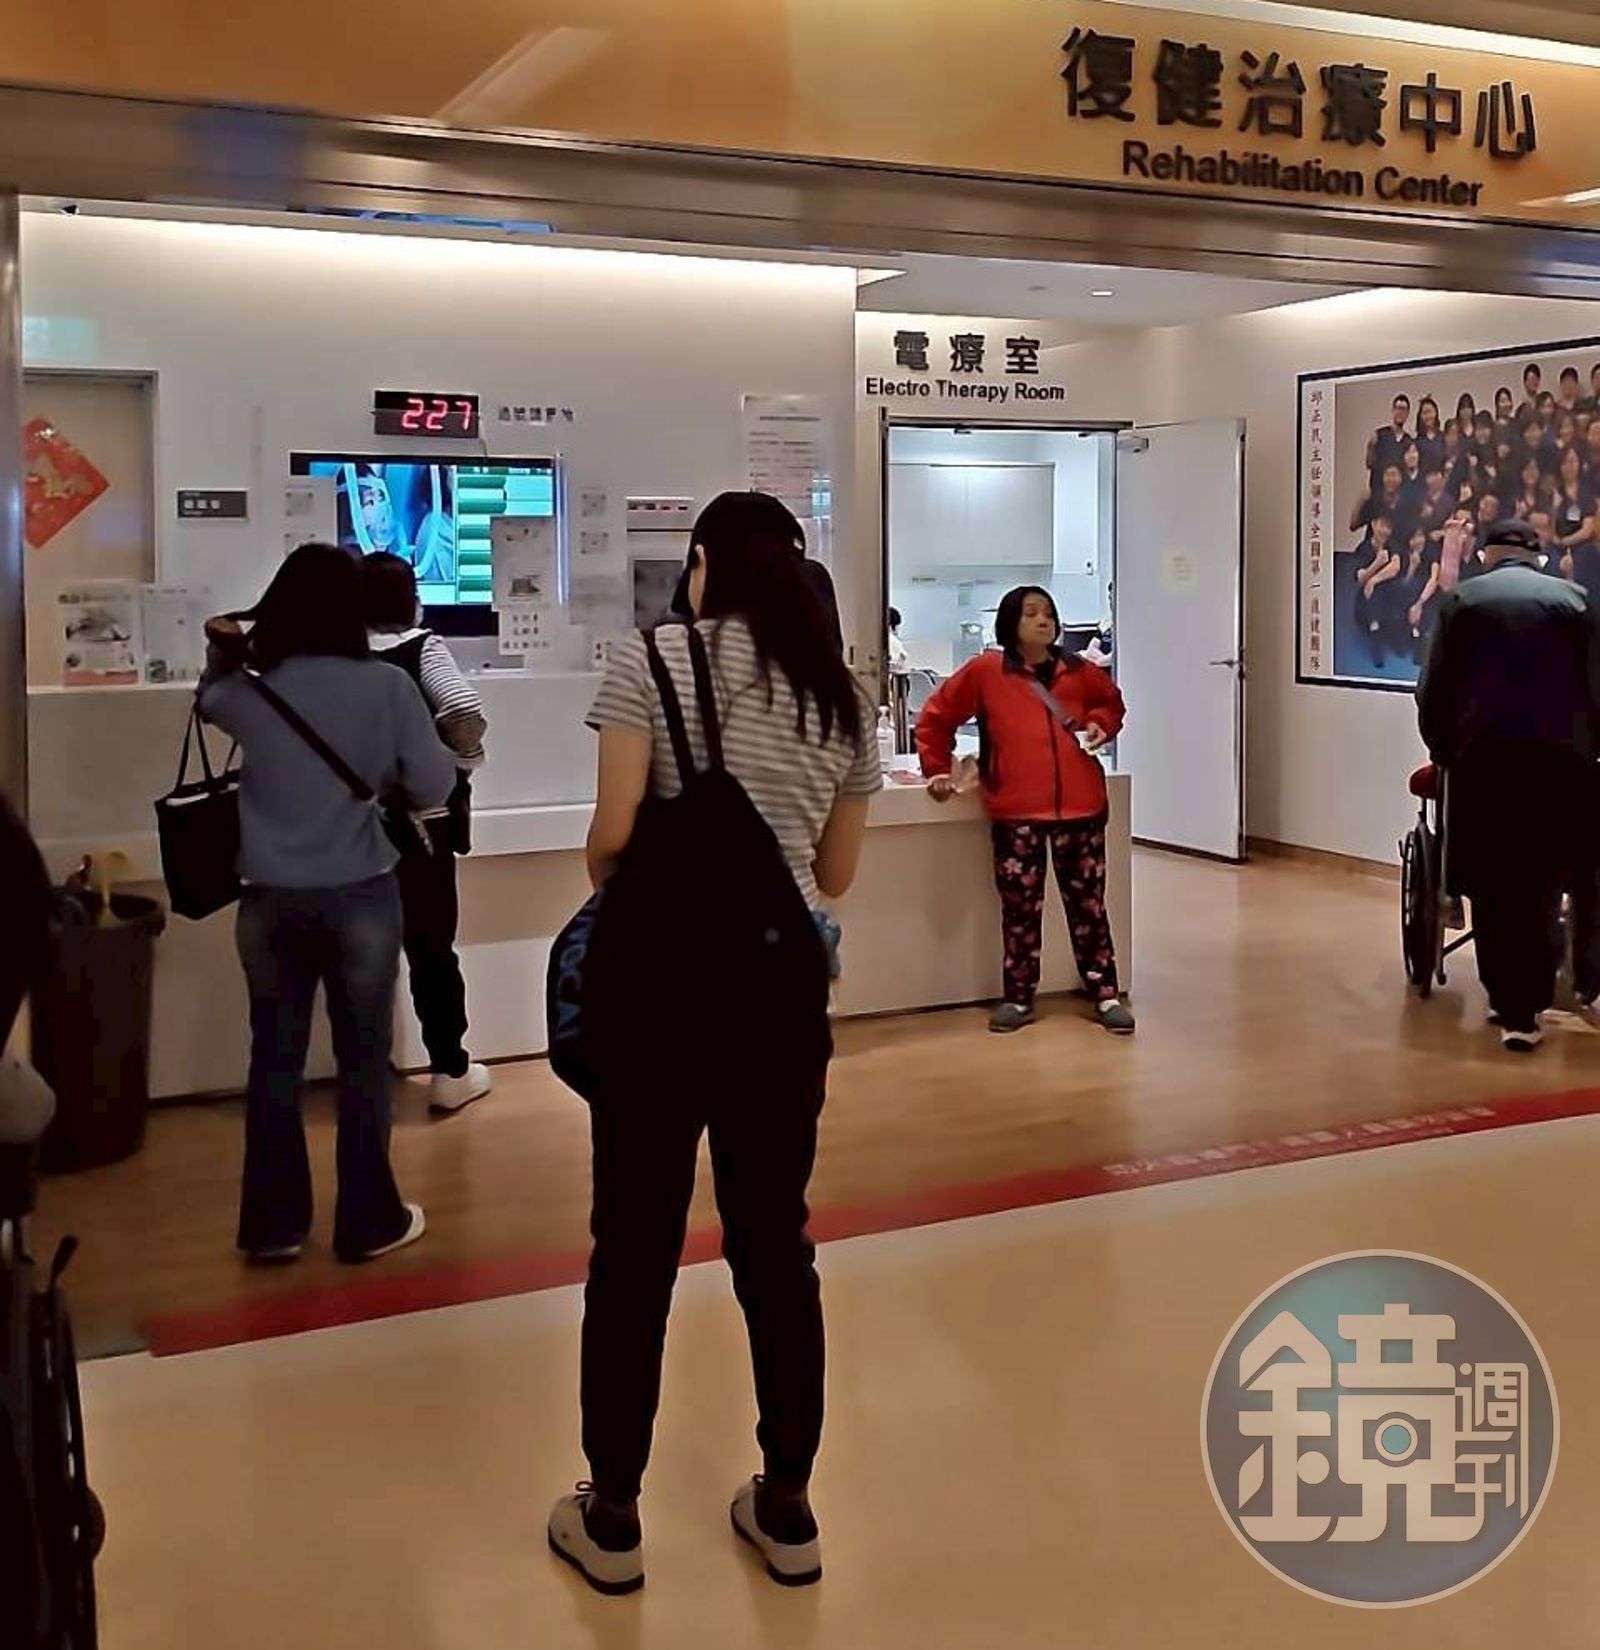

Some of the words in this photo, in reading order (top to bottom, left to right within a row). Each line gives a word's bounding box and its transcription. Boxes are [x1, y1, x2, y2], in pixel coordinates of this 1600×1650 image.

[1061, 27, 1536, 160] 復健治療中心
[1122, 140, 1364, 197] Rehabilitation
[1375, 166, 1484, 207] Center
[893, 330, 1041, 375] 電療室
[865, 377, 931, 398] Electro
[936, 379, 1009, 403] Therapy
[1014, 382, 1065, 401] Room
[401, 398, 474, 431] 227
